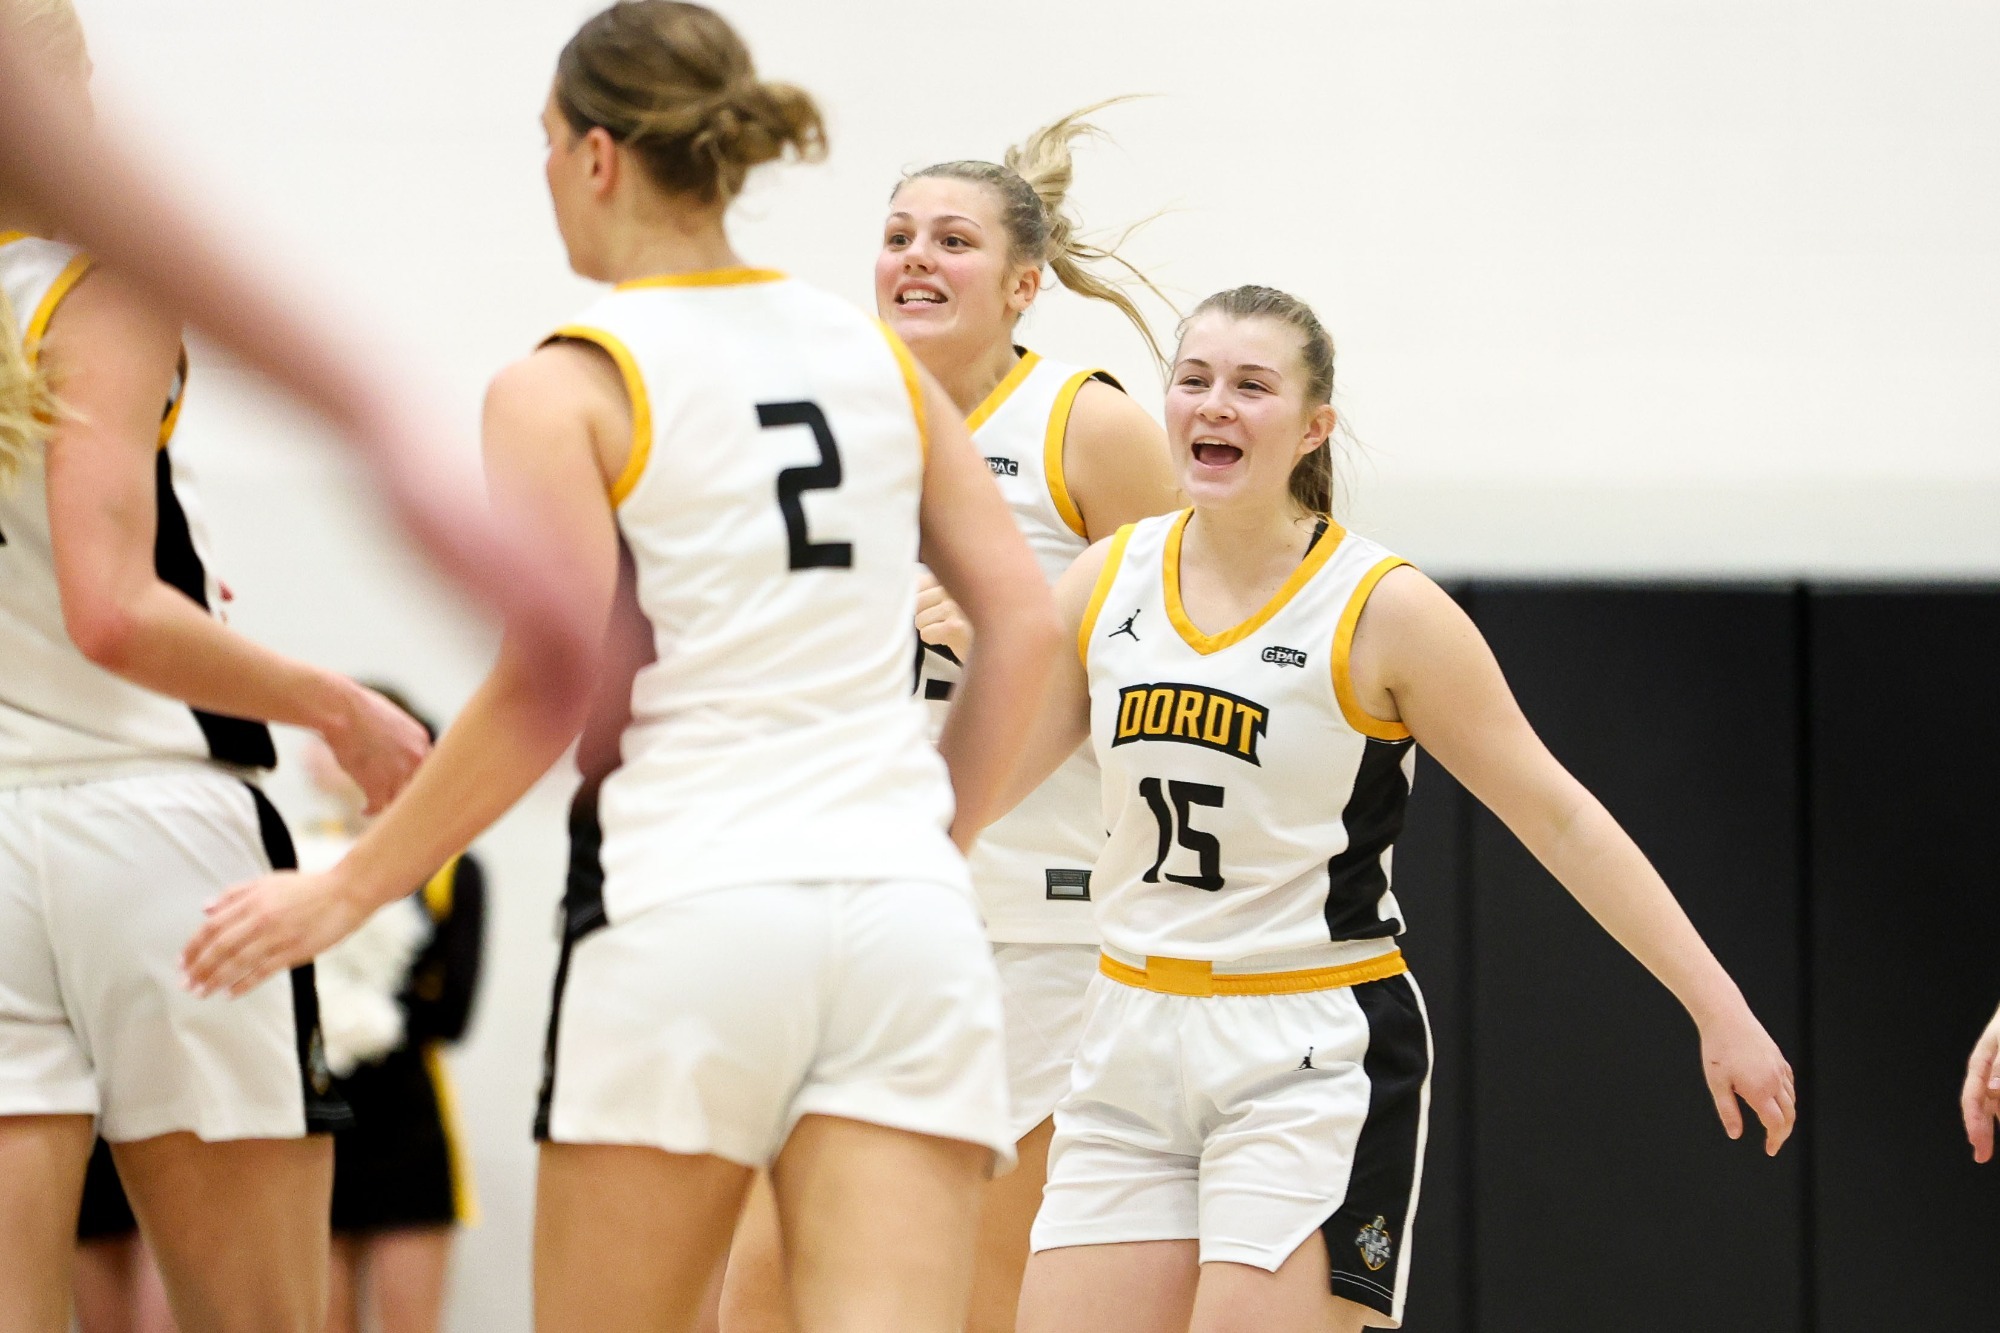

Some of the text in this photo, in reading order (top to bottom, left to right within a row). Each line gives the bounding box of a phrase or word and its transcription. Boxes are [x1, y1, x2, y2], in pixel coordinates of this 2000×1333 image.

[755, 400, 853, 571] 2
[1262, 647, 1306, 667] GPAC
[1115, 686, 1265, 759] DORDT
[1138, 776, 1225, 892] 15
